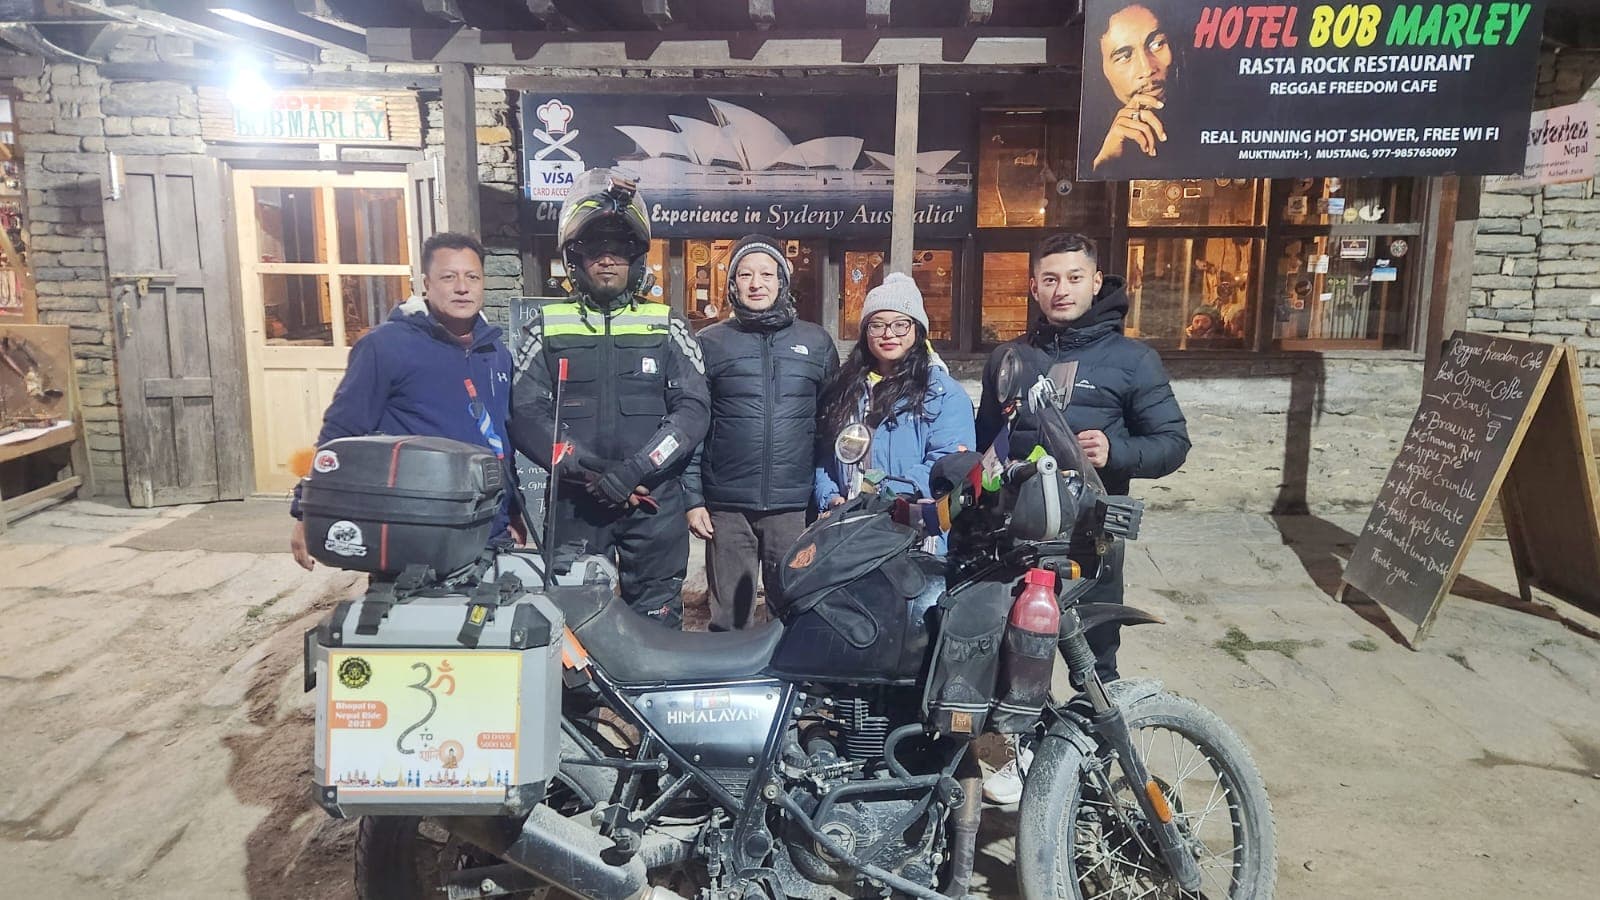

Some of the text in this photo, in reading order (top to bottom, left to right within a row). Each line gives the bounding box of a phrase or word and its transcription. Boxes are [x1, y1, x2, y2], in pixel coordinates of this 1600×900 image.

[1193, 3, 1531, 49] HOTEL BOB MARLEY
[1239, 54, 1474, 75] RASTA ROCK RESTAURANT
[1270, 79, 1437, 95] REGGAE FREEDOM CAFE
[1200, 127, 1500, 144] REAL RUNNING HOT SHOWER, FREE WI FI
[1238, 147, 1457, 161] MUKTINATH-1, MUSTANG, 977-9857650097
[1563, 142, 1588, 157] Nepal
[542, 172, 574, 184] VISA
[533, 187, 570, 197] CARD ACCE
[651, 204, 738, 226] Experience
[744, 206, 761, 223] in
[767, 204, 844, 230] Sydeny
[850, 204, 963, 224] Ausalia"
[1449, 338, 1482, 367] Reggae
[1520, 350, 1544, 371] Cafe
[1454, 370, 1492, 396] Organic
[1491, 377, 1523, 400] Coffee
[1428, 411, 1476, 443] Brownie
[1414, 446, 1440, 464] Apple
[1460, 444, 1481, 462] Roll
[1406, 462, 1476, 501] Apple Crumble
[1395, 480, 1463, 524] Hot Chocolate
[1408, 515, 1431, 543] Apple
[1371, 547, 1392, 570] Thank
[335, 702, 377, 711] Bhopal to
[336, 711, 382, 721] Nepal Ride
[667, 708, 760, 725] HIMALAYAN
[419, 733, 434, 741] TO
